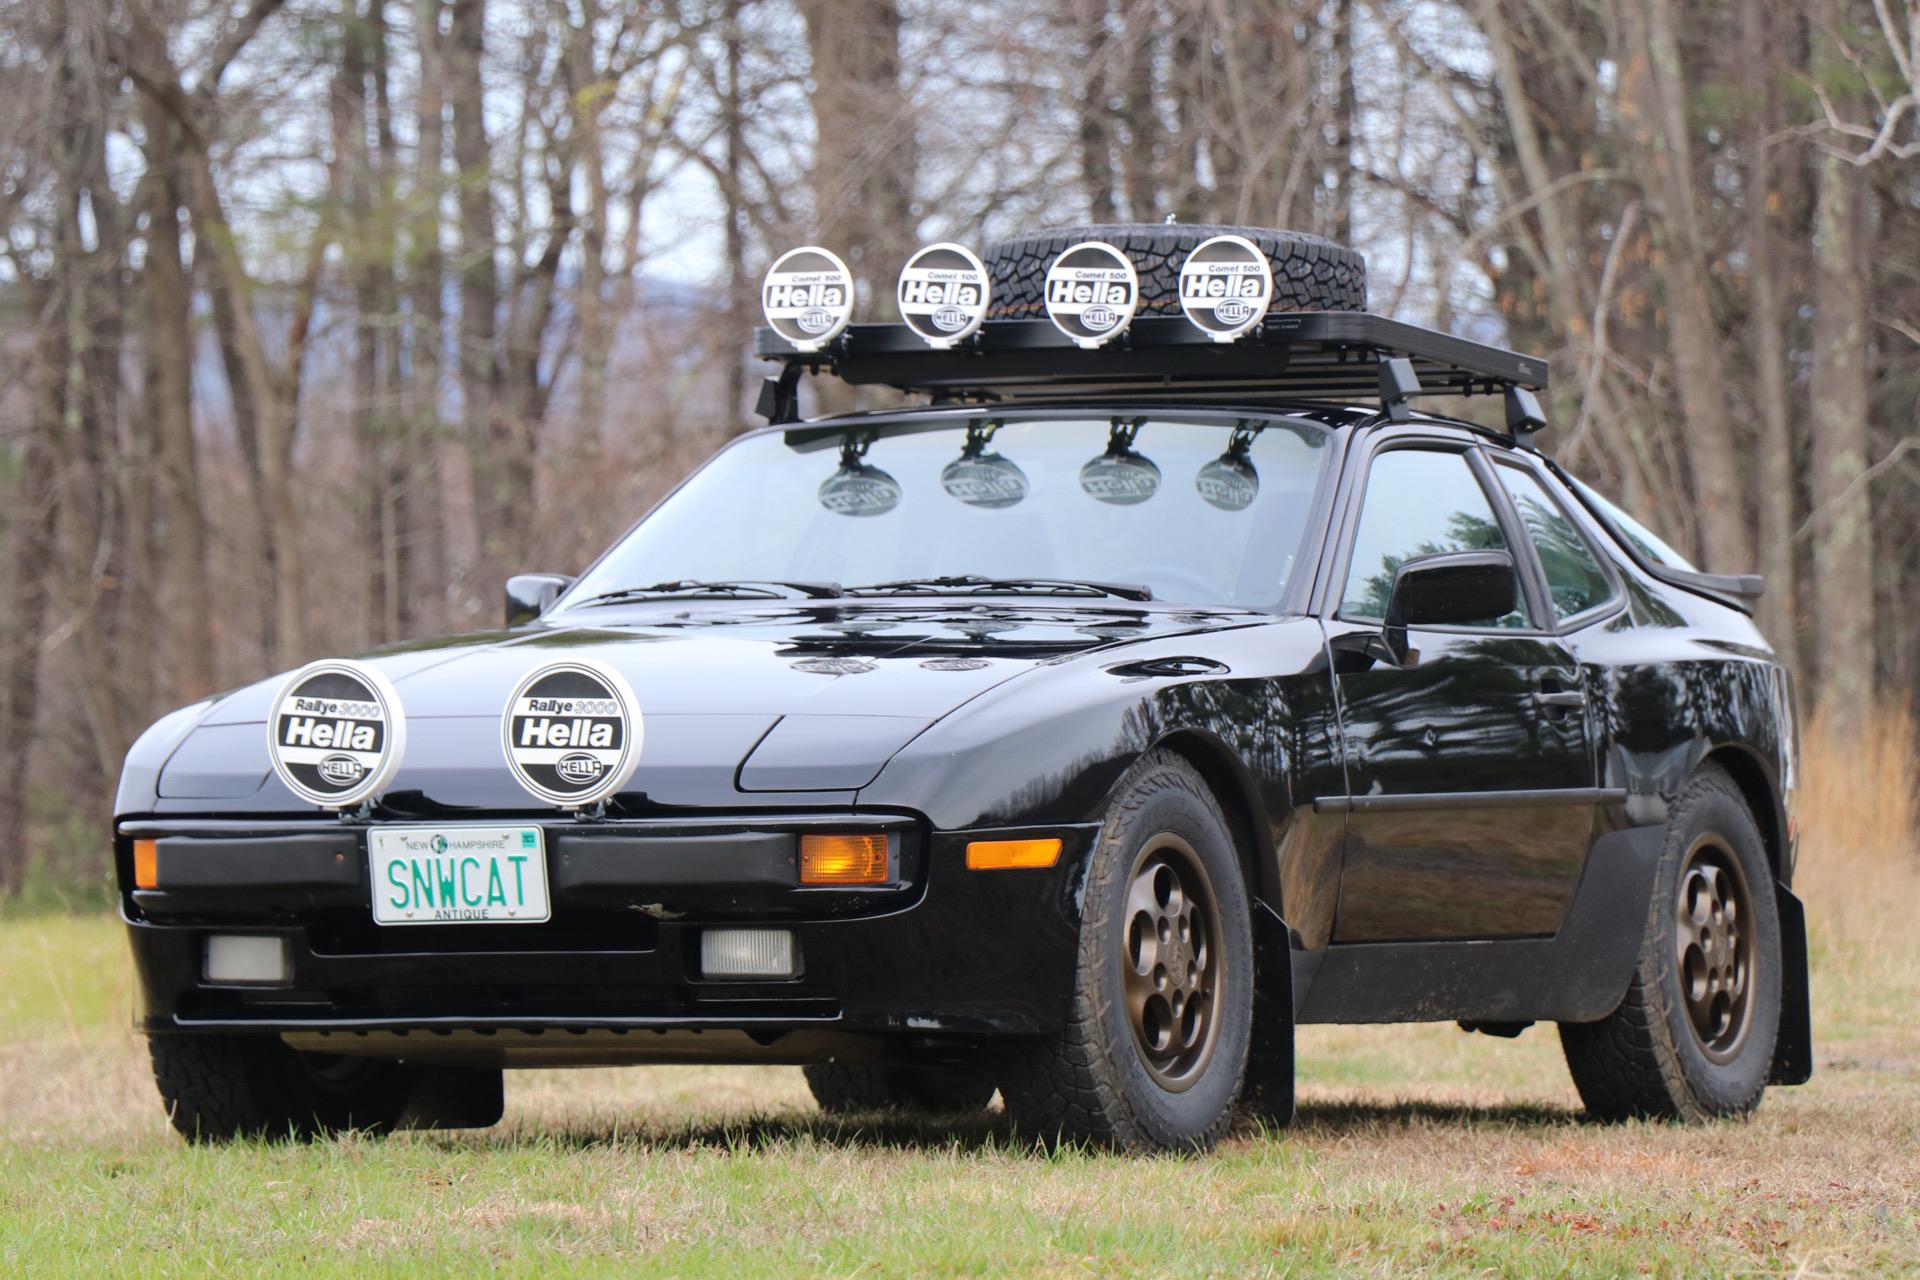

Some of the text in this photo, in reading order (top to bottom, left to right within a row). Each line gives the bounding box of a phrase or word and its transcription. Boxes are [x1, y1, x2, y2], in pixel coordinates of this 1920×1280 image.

[1075, 271, 1127, 280] Comet 500
[1208, 264, 1261, 273] Comet 500
[904, 280, 978, 305] Hella
[1051, 280, 1127, 304] Hella
[1185, 274, 1260, 298] Hella
[768, 284, 842, 308] Hella
[801, 312, 833, 325] HELLA
[934, 312, 967, 324] HELLA
[1084, 311, 1116, 323] HELLA
[1217, 305, 1250, 317] HELLA
[295, 699, 381, 718] Rallye 3000
[528, 699, 618, 714] Rallye 3000
[285, 716, 376, 750] Hella
[520, 717, 614, 747] Hella
[322, 762, 363, 776] HELLA
[560, 760, 601, 775] HELLA
[406, 840, 506, 851] NEW HAMPSHIRE
[388, 855, 528, 909] SNWCAT
[435, 908, 490, 920] ANTIQUE
